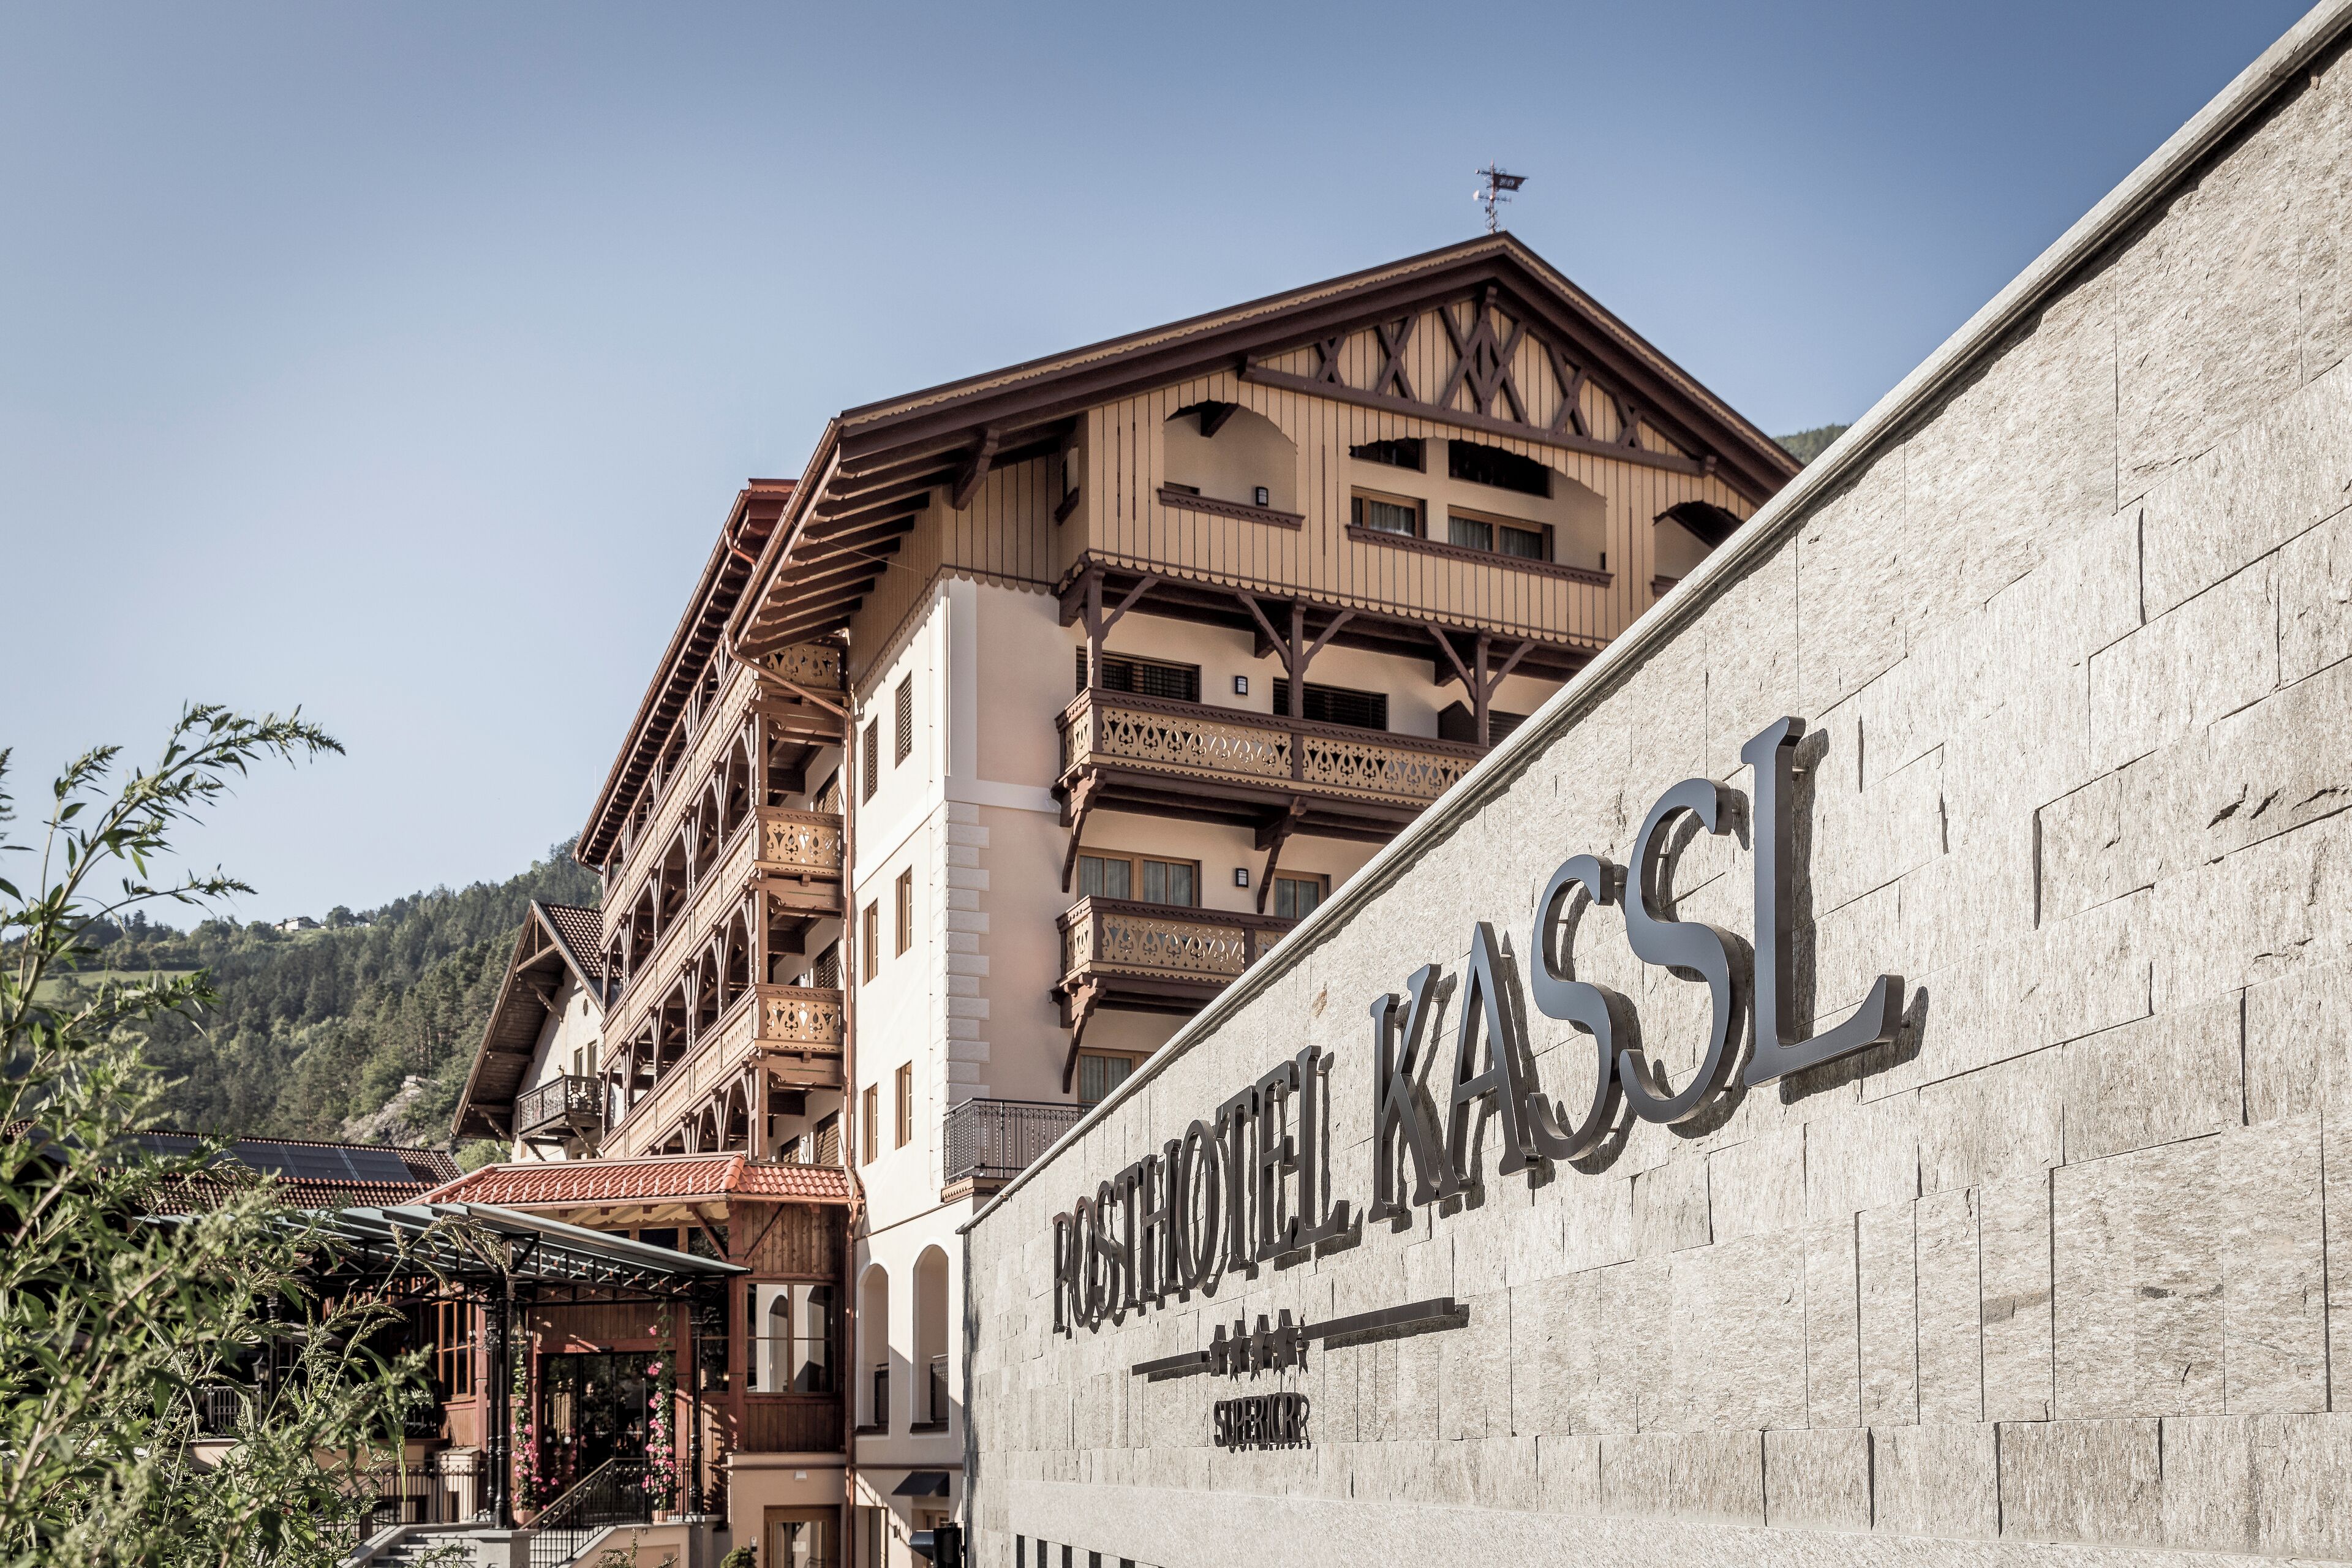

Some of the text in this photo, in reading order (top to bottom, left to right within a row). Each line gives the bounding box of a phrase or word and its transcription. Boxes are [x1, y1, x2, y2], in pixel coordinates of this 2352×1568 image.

[1053, 717, 1904, 1333] POSTHOTEL KASSL
[1214, 1392, 1302, 1447] SUPERIOR
